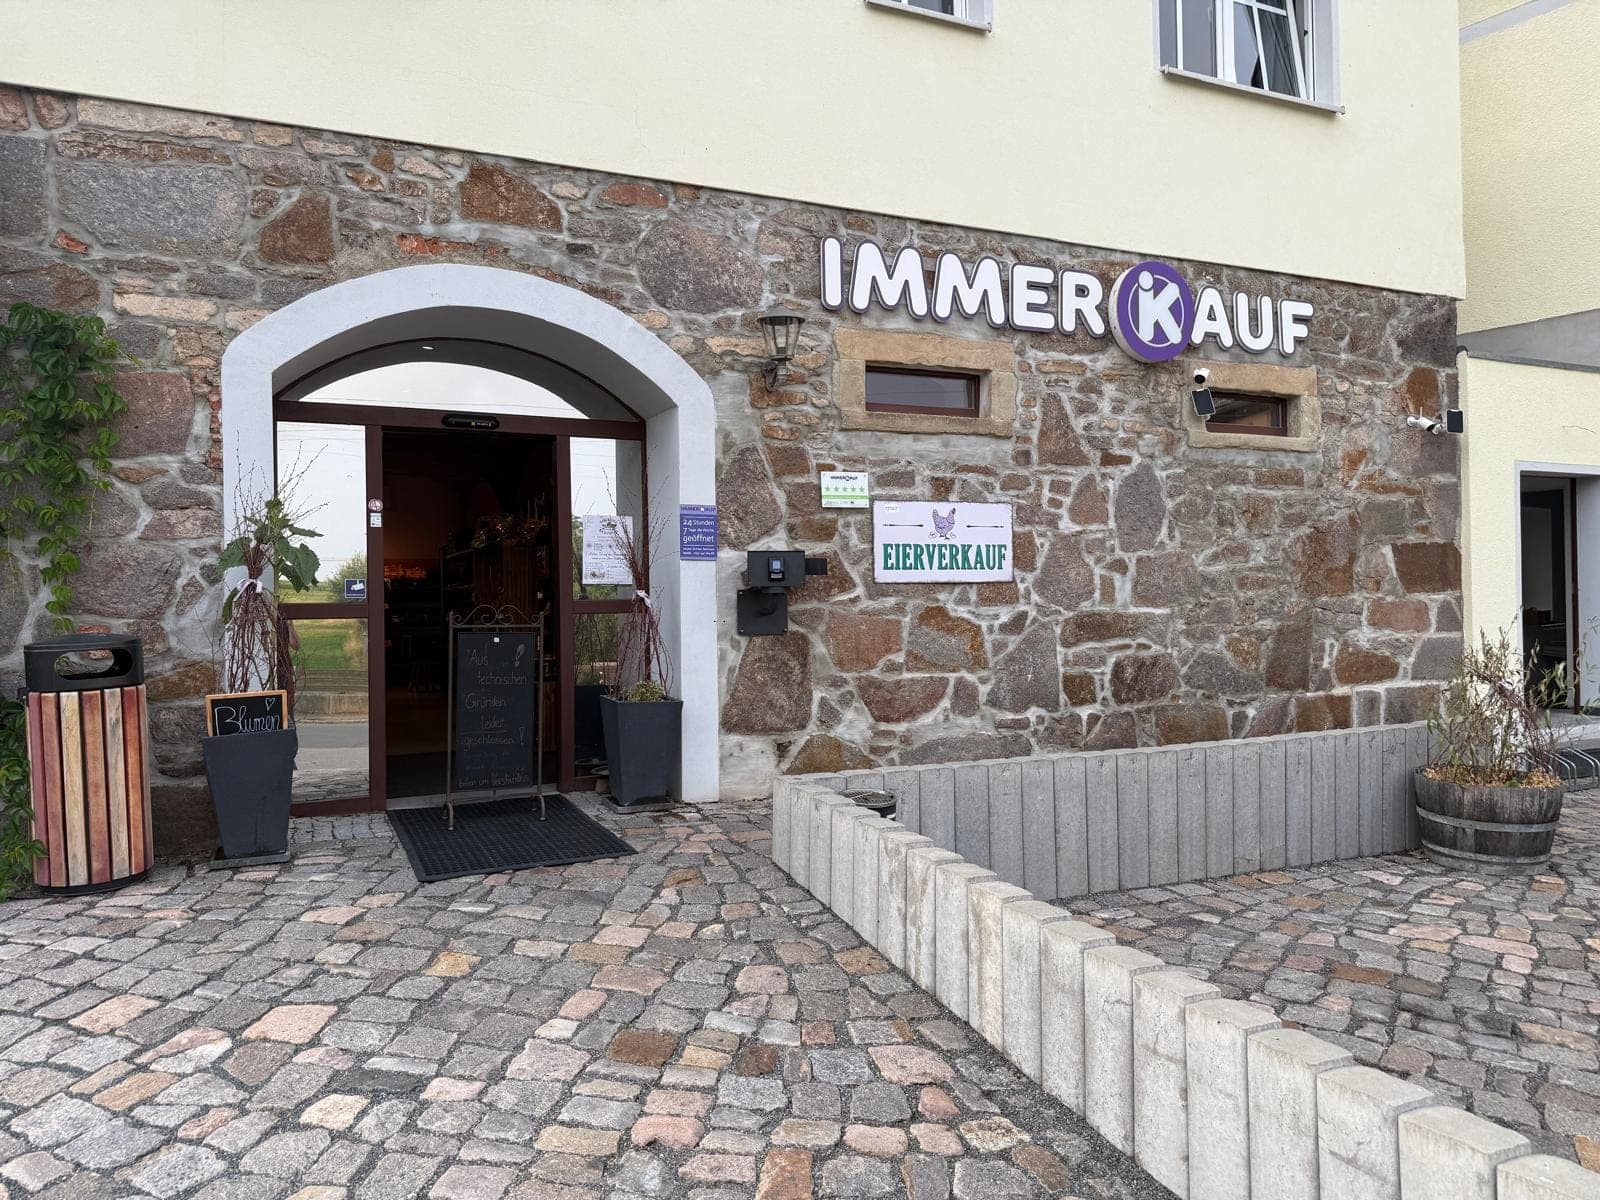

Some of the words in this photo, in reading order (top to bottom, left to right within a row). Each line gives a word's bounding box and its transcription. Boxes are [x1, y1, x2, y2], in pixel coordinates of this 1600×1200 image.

[683, 534, 715, 543] geöffnet
[883, 543, 1007, 570] EIERVERKAUF
[214, 705, 280, 737] Blumen
